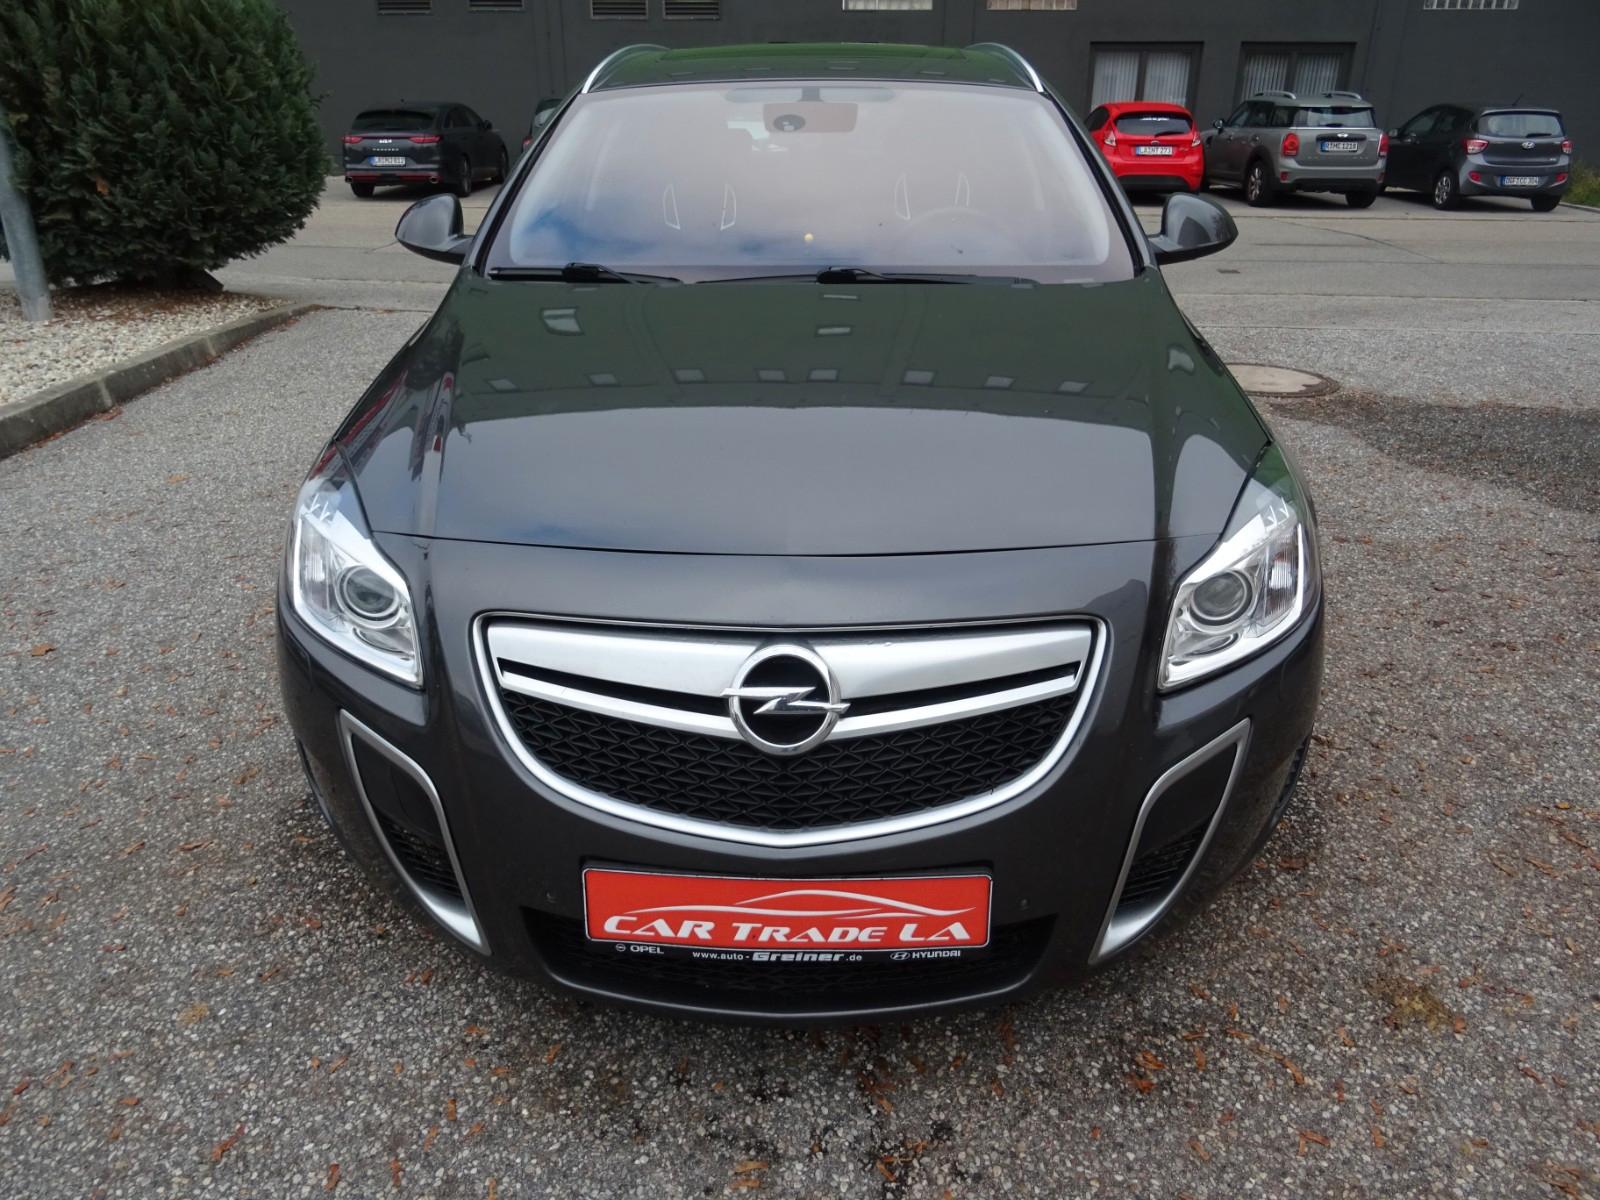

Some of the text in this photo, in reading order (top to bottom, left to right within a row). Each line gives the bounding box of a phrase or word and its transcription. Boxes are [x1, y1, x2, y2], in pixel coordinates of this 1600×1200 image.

[603, 915, 971, 943] CAR TRADE LA
[629, 945, 665, 955] OPEL
[911, 949, 961, 960] HYUNDAI
